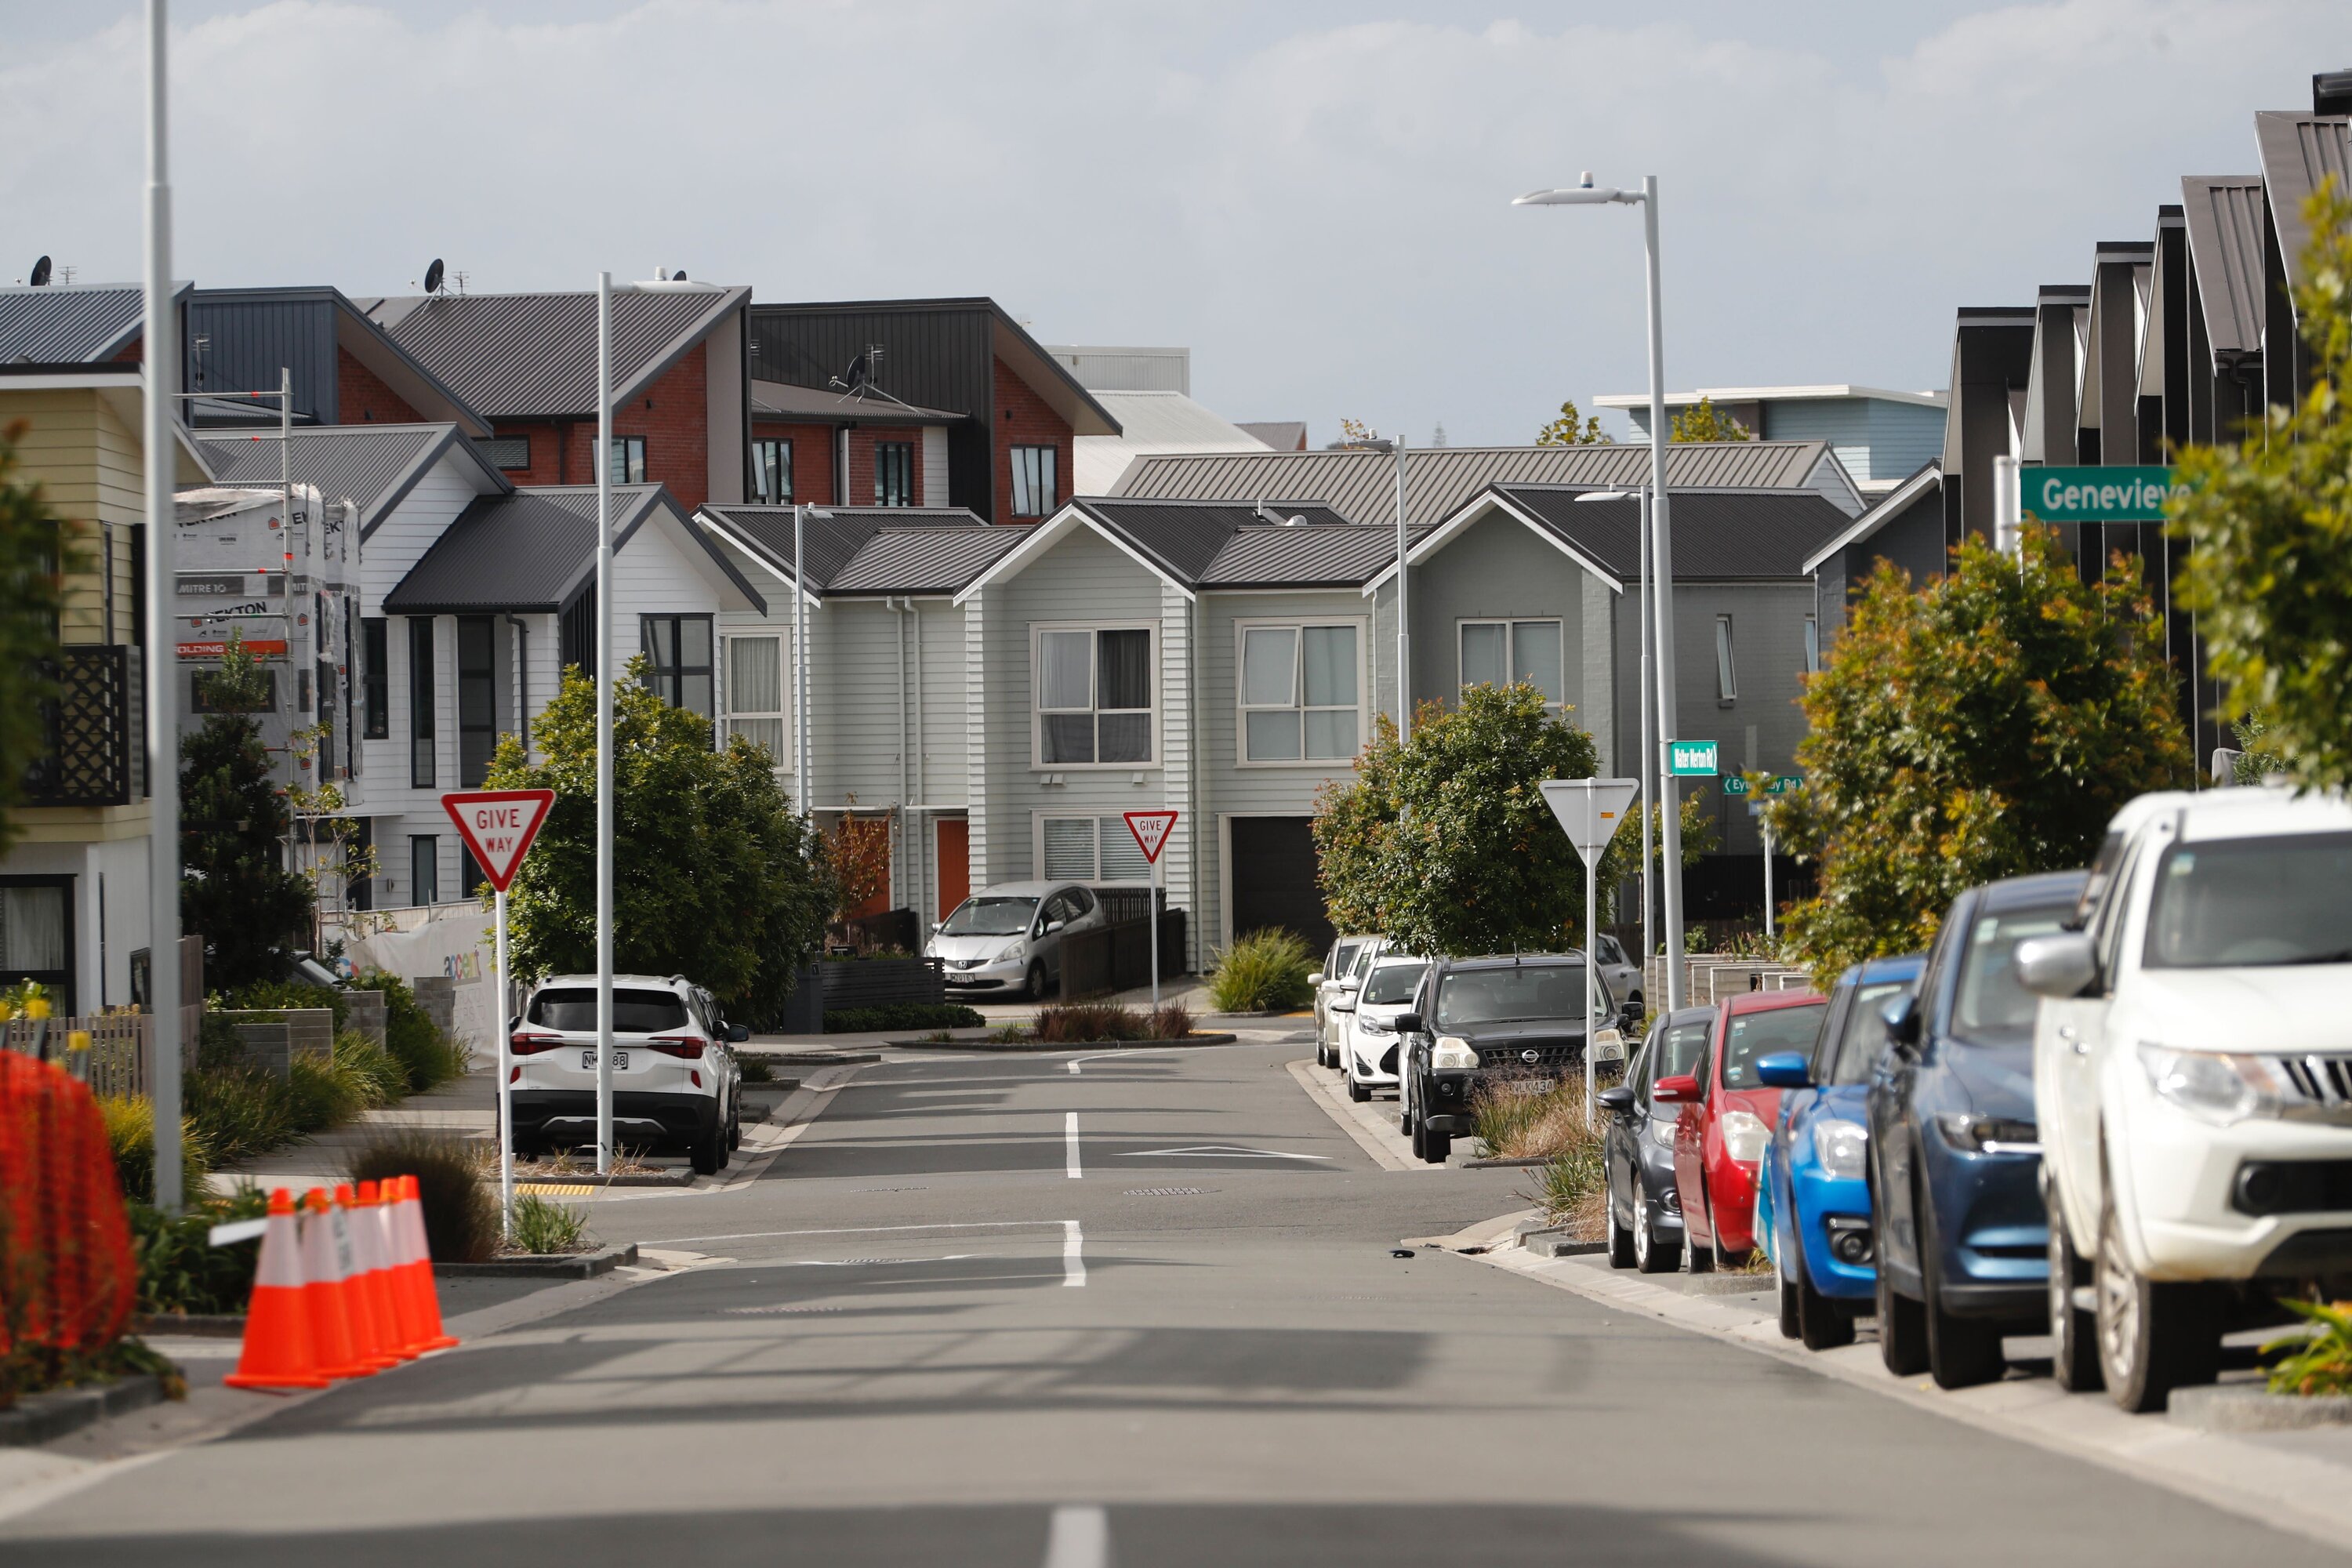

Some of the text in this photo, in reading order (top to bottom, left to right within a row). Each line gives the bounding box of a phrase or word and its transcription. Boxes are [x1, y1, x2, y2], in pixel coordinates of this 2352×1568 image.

[178, 584, 227, 593] MITRE 10
[1675, 748, 1690, 768] Walter
[1706, 748, 1713, 768] Rd
[477, 809, 521, 829] GIVE
[1140, 820, 1162, 831] GIVE
[485, 837, 513, 853] WAY
[1145, 835, 1158, 844] WAY
[584, 1054, 626, 1066] NM88
